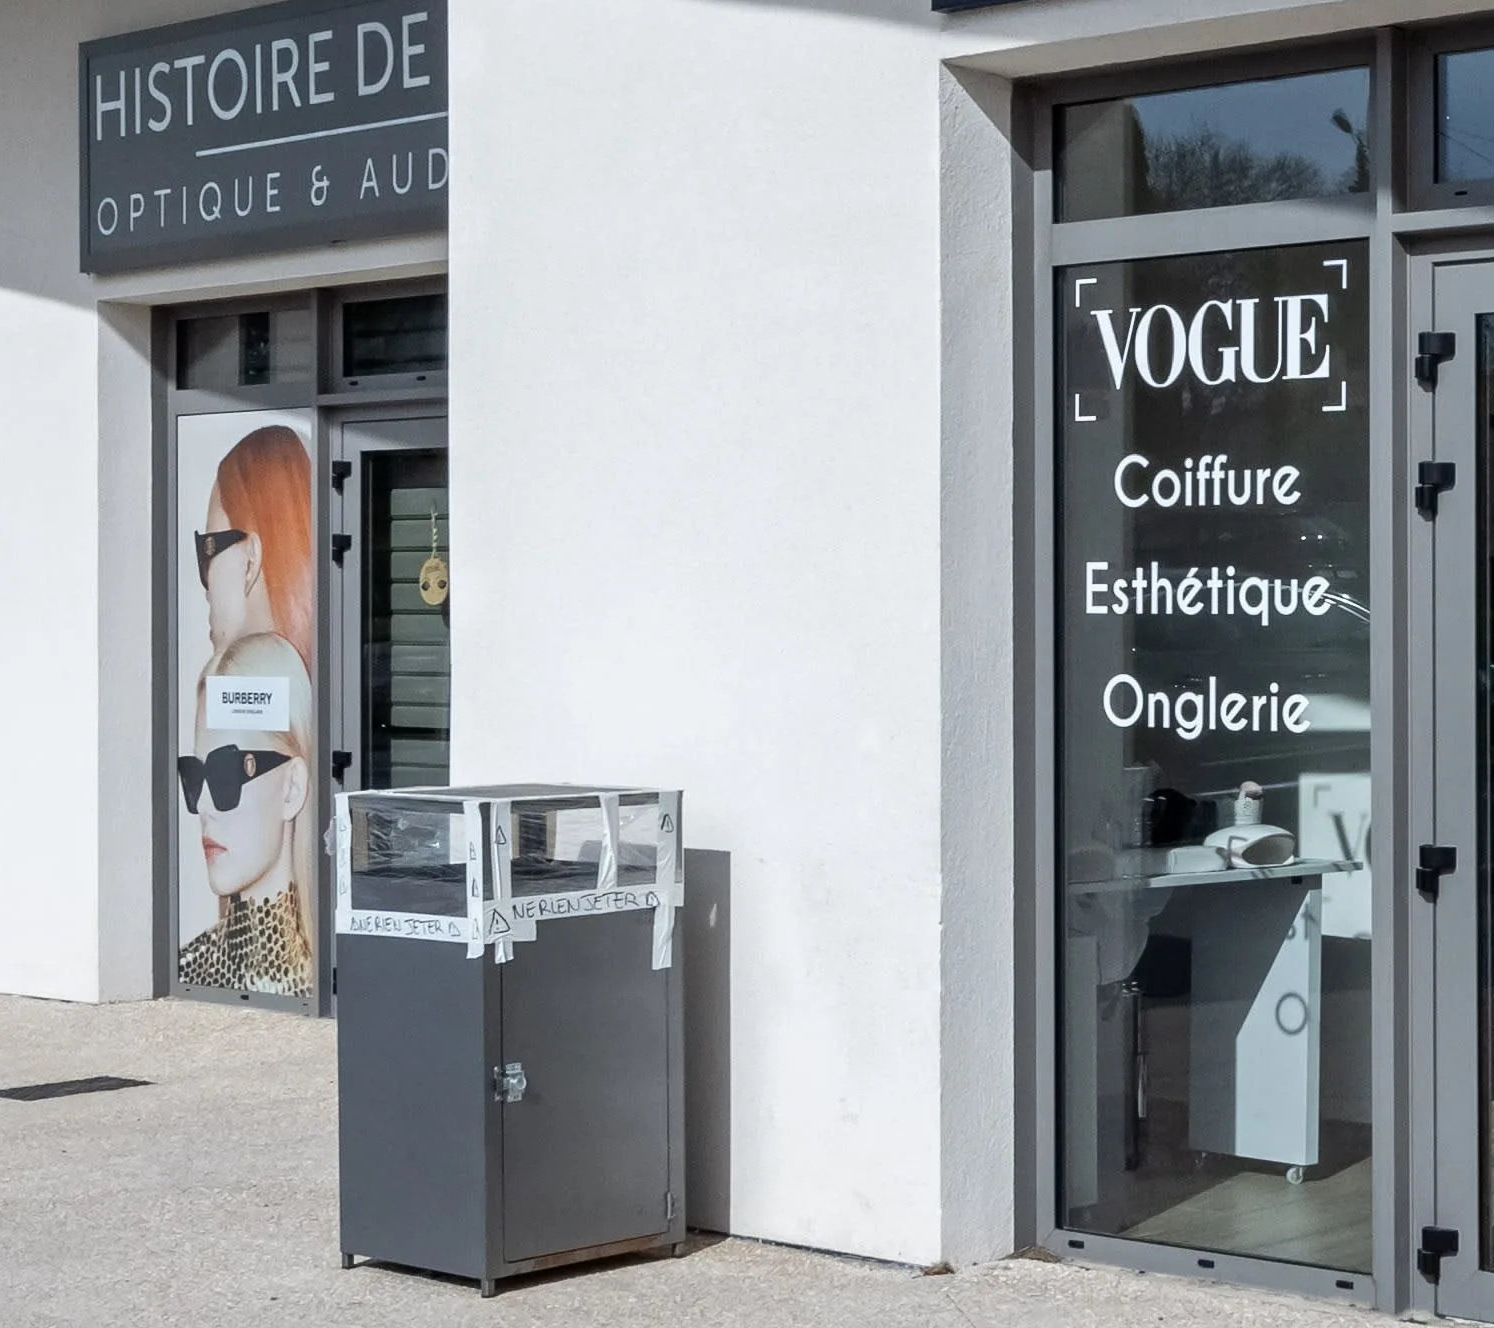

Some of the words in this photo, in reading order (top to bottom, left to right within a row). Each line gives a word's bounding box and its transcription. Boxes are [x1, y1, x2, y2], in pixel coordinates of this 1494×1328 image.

[96, 30, 335, 141] HISTOIRE
[357, 11, 431, 97] DE
[97, 171, 281, 236] OPTIQUE
[310, 164, 330, 206] &
[360, 147, 448, 200] AUD
[1090, 293, 1330, 390] VOGUE
[1114, 453, 1302, 508] Coiffure
[1085, 561, 1331, 627] Esthétique
[222, 691, 272, 705] BURBERRY
[1103, 674, 1311, 740] Onglerie
[512, 901, 535, 920] NE
[539, 898, 581, 916] RIEN
[581, 891, 640, 911] JETER
